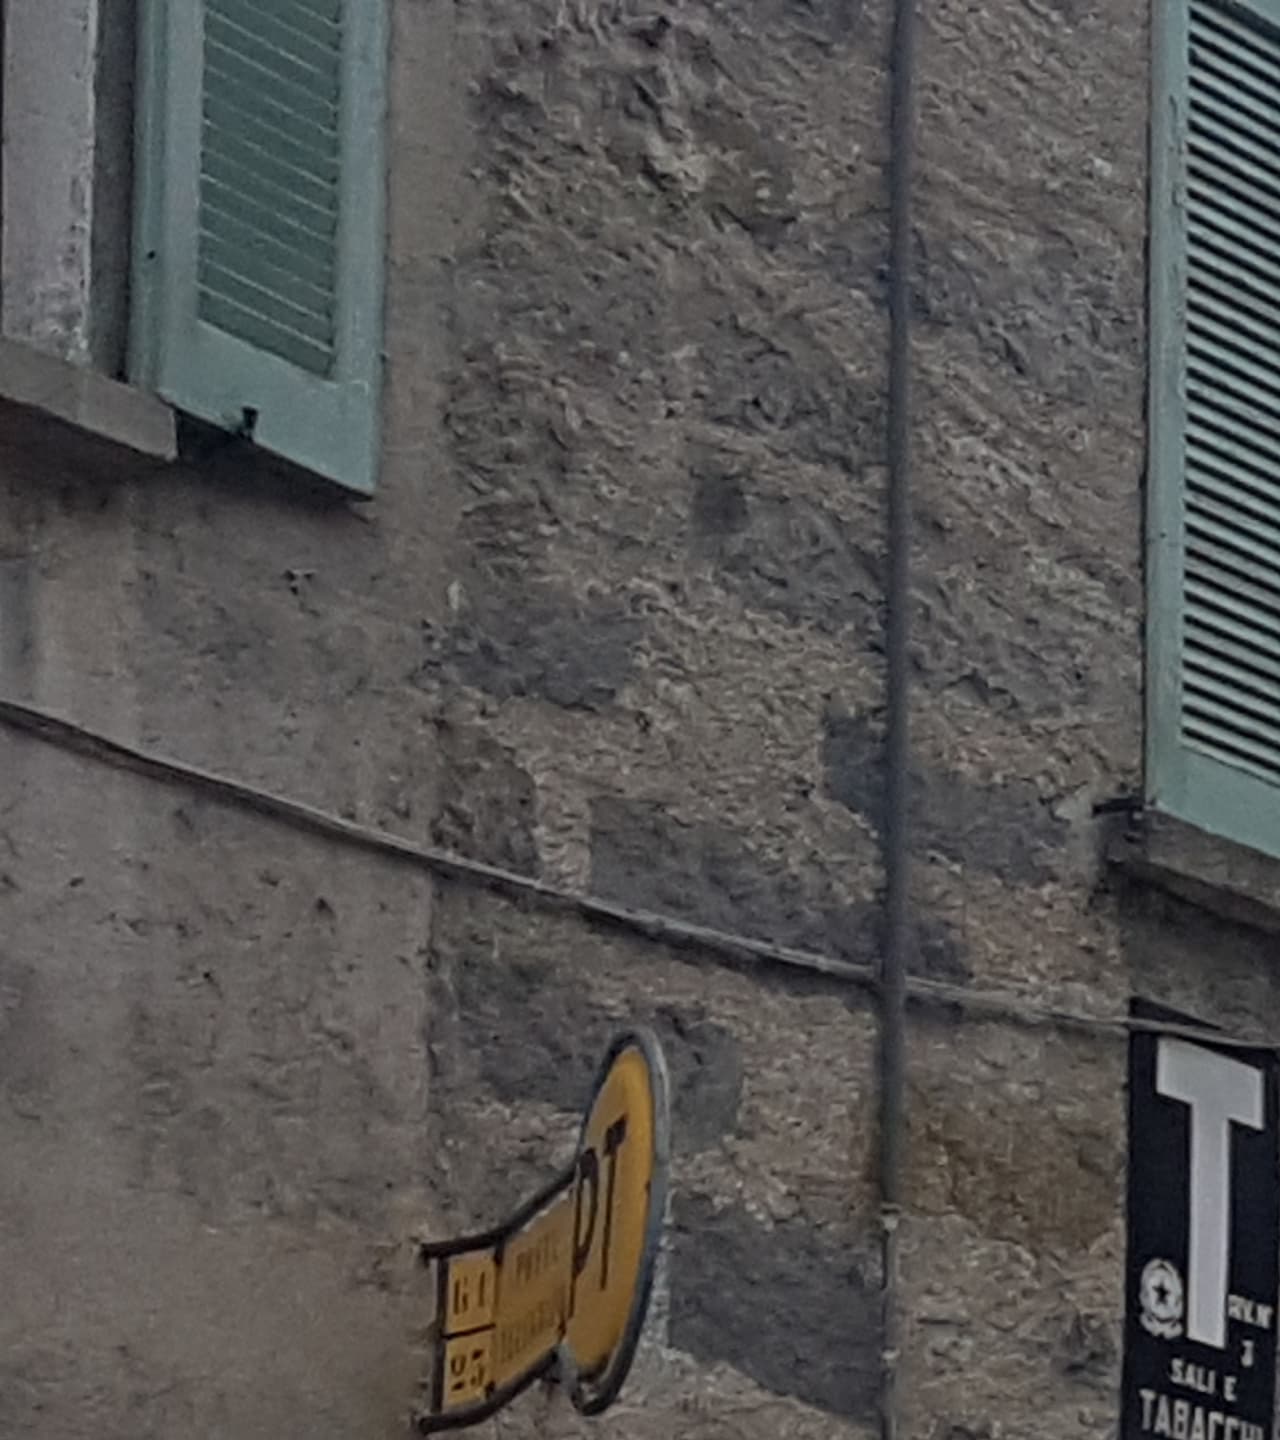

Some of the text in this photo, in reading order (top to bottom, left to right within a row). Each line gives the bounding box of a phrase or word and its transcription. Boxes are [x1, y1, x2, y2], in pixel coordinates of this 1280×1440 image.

[1155, 1036, 1266, 1350] T
[1169, 1357, 1239, 1403] SALI E
